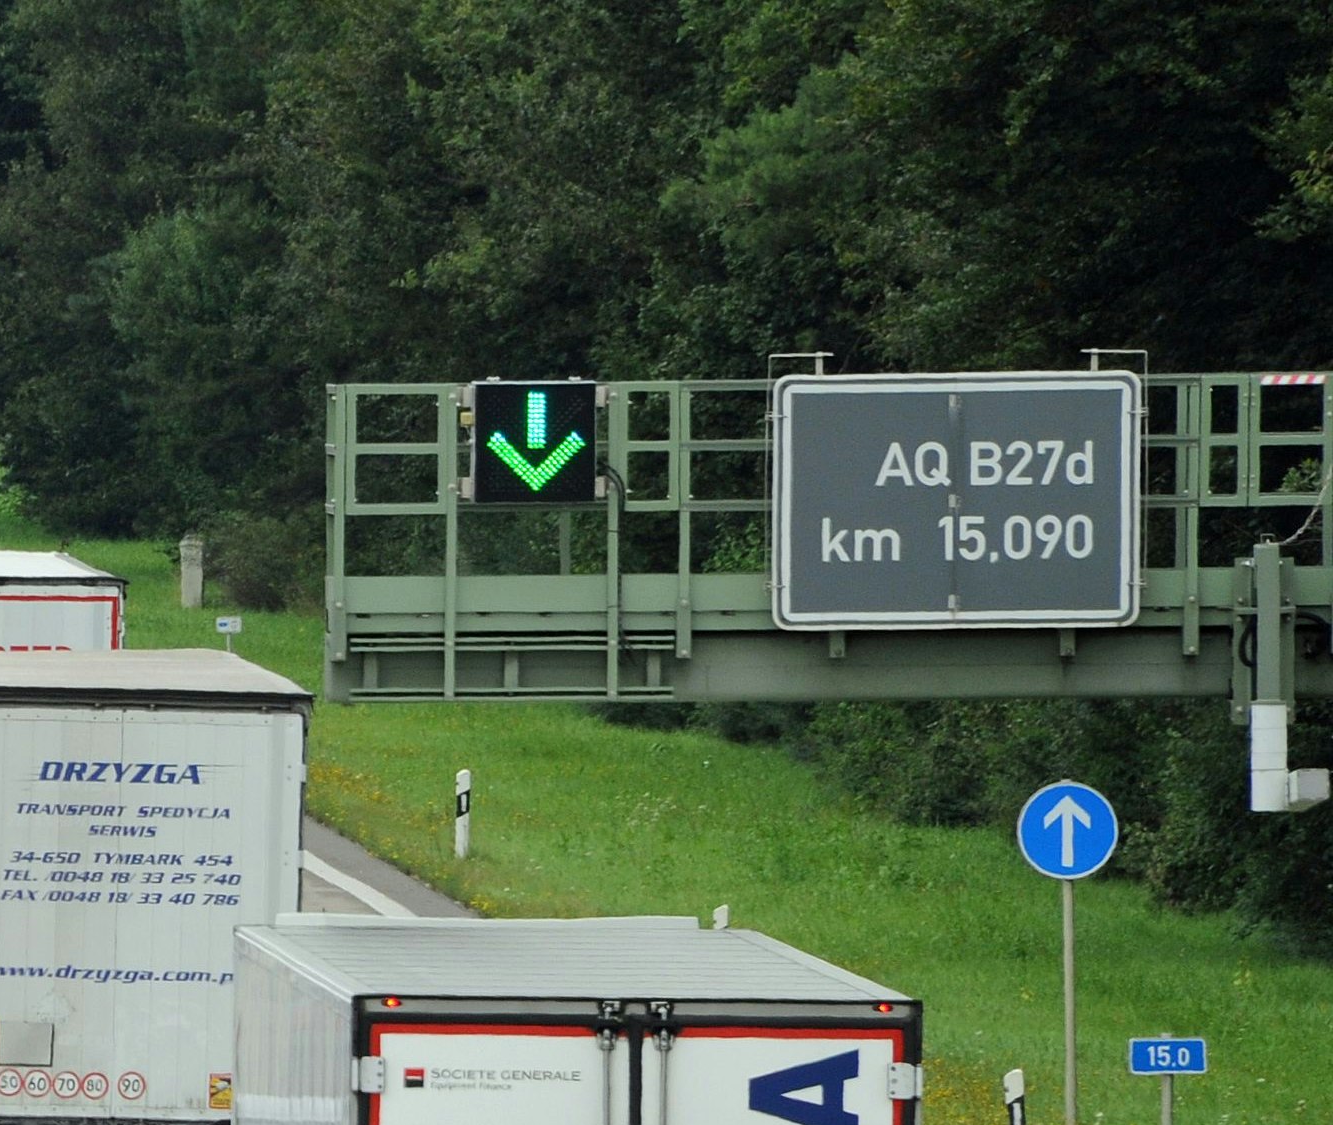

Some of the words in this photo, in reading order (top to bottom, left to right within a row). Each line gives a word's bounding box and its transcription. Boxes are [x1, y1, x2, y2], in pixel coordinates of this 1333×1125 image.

[875, 441, 951, 487] AQ
[970, 440, 1094, 486] B27d
[822, 517, 901, 563] km
[938, 514, 1093, 563] 15,090
[38, 761, 201, 784] DRZYZGA
[16, 803, 128, 818] TRANSPORT
[137, 805, 231, 820] SPEDYCJA
[88, 825, 157, 838] SERWIS
[10, 852, 81, 865] 34-650
[93, 853, 183, 867] TYMBARK
[193, 855, 233, 867] 454
[3, 870, 38, 882] TEL.
[140, 872, 165, 885] 33
[170, 873, 196, 885] 25
[203, 873, 242, 887] 740
[0, 890, 37, 902] FAX
[138, 892, 163, 905] 33
[170, 893, 196, 906] 40
[202, 893, 239, 907] 786
[1147, 1045, 1190, 1067] 15.0
[0, 1075, 18, 1089] 50
[430, 1068, 496, 1081] SOCIETE
[501, 1069, 581, 1082] GENERALE
[27, 1077, 46, 1091] 60
[58, 1078, 75, 1092] 70
[86, 1079, 103, 1092] 80
[121, 1078, 140, 1092] 90
